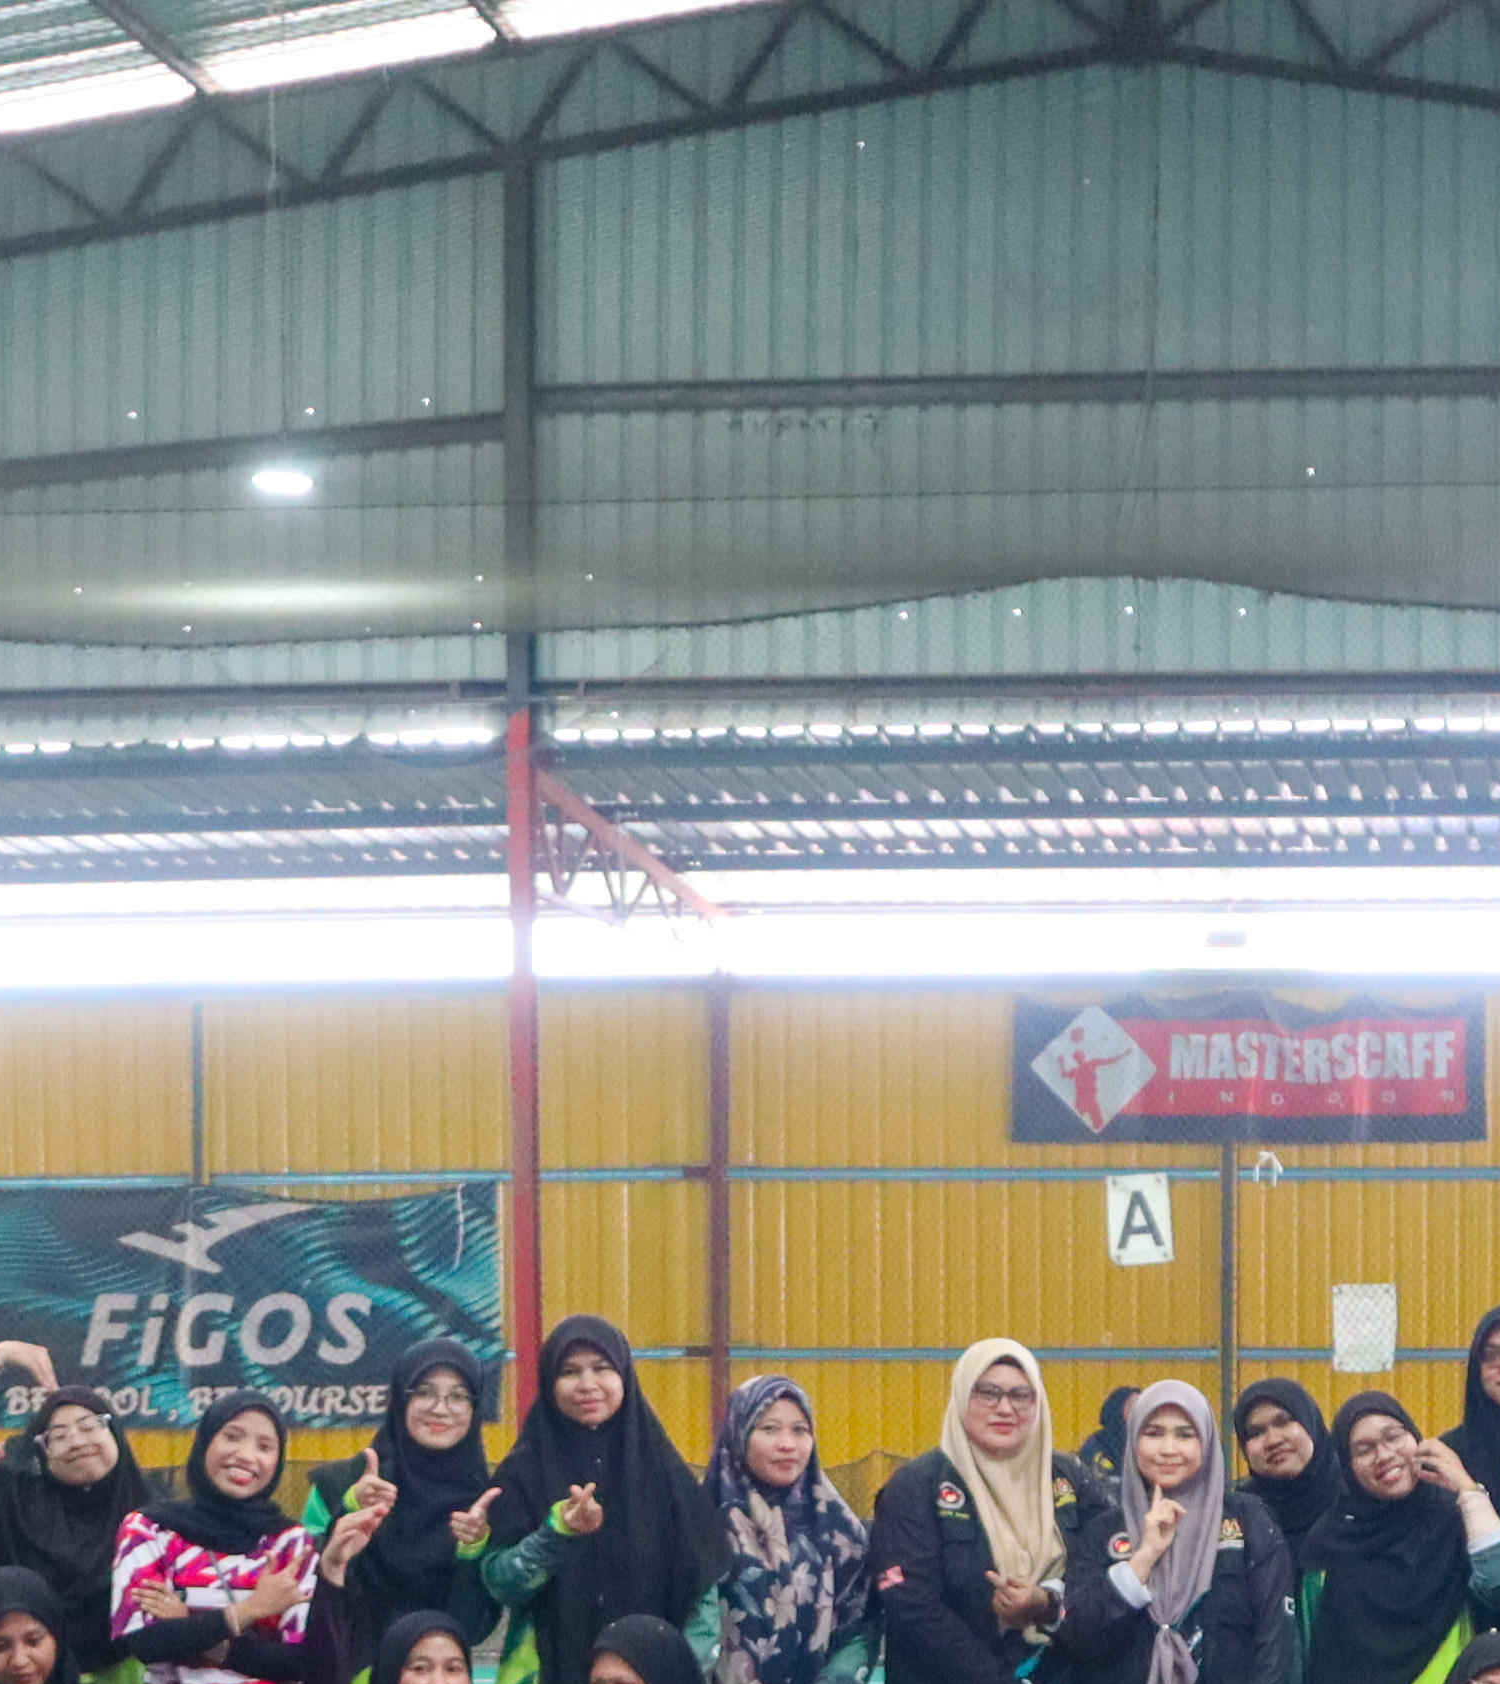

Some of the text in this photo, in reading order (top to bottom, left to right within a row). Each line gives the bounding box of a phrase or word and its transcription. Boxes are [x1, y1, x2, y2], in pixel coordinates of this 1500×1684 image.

[1168, 1029, 1456, 1084] MASTERSCAFF
[1117, 1189, 1166, 1250] A
[80, 1291, 373, 1367] FiGOS
